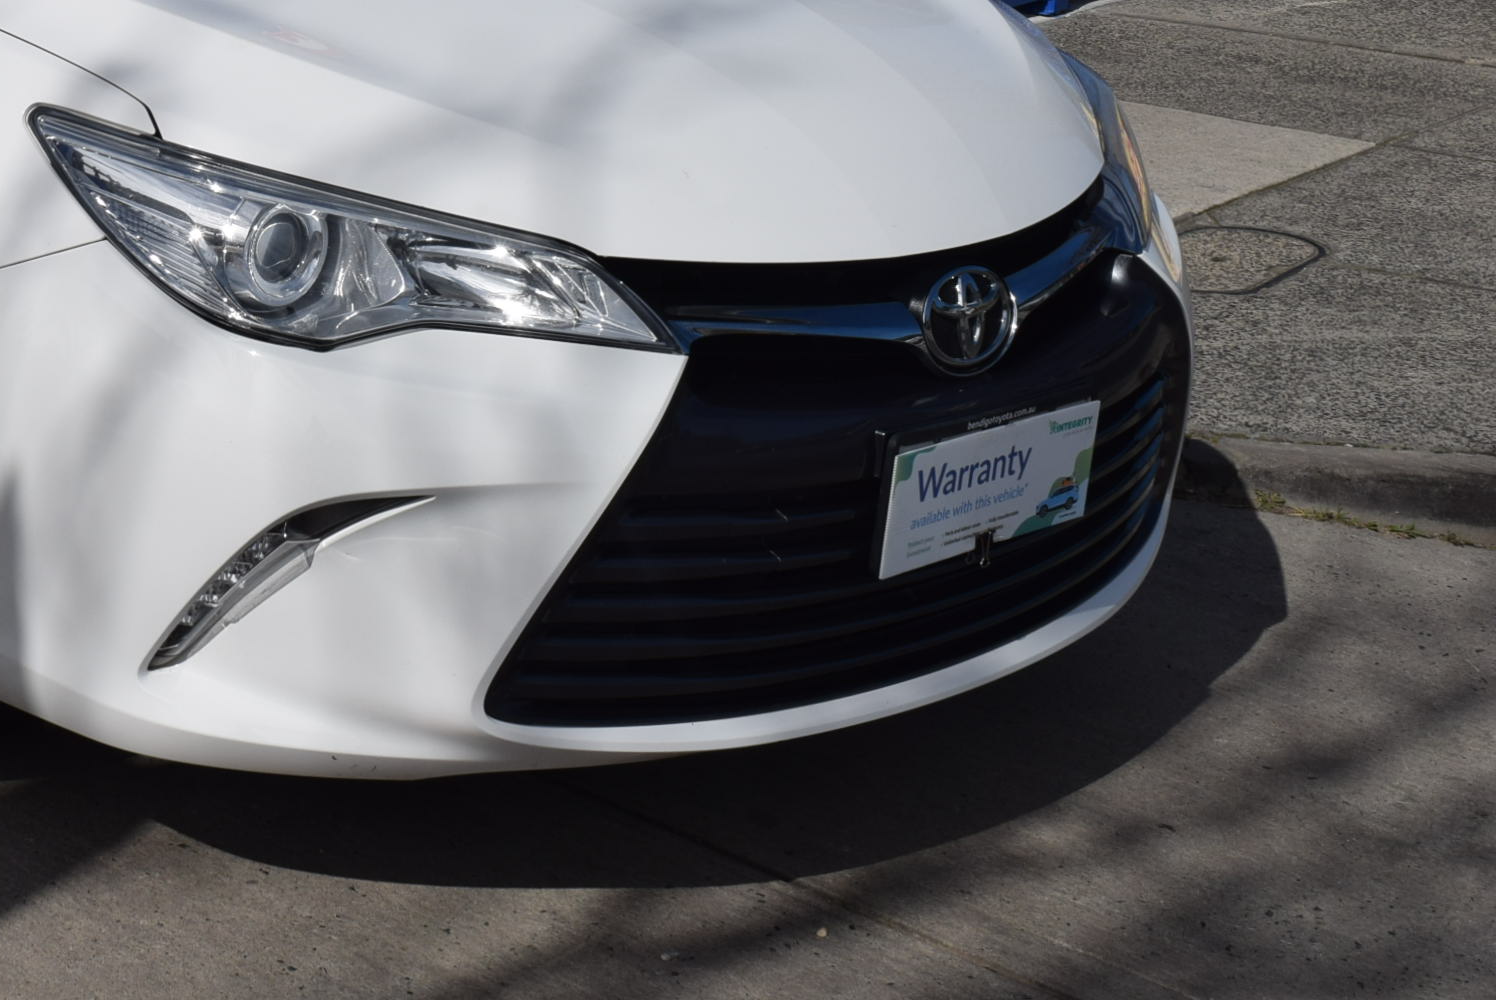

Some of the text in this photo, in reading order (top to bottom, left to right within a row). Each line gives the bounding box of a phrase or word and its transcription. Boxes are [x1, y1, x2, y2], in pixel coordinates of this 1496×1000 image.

[917, 445, 1032, 502] Warranty
[910, 505, 951, 530] available
[952, 496, 973, 517] with
[974, 491, 991, 511] this
